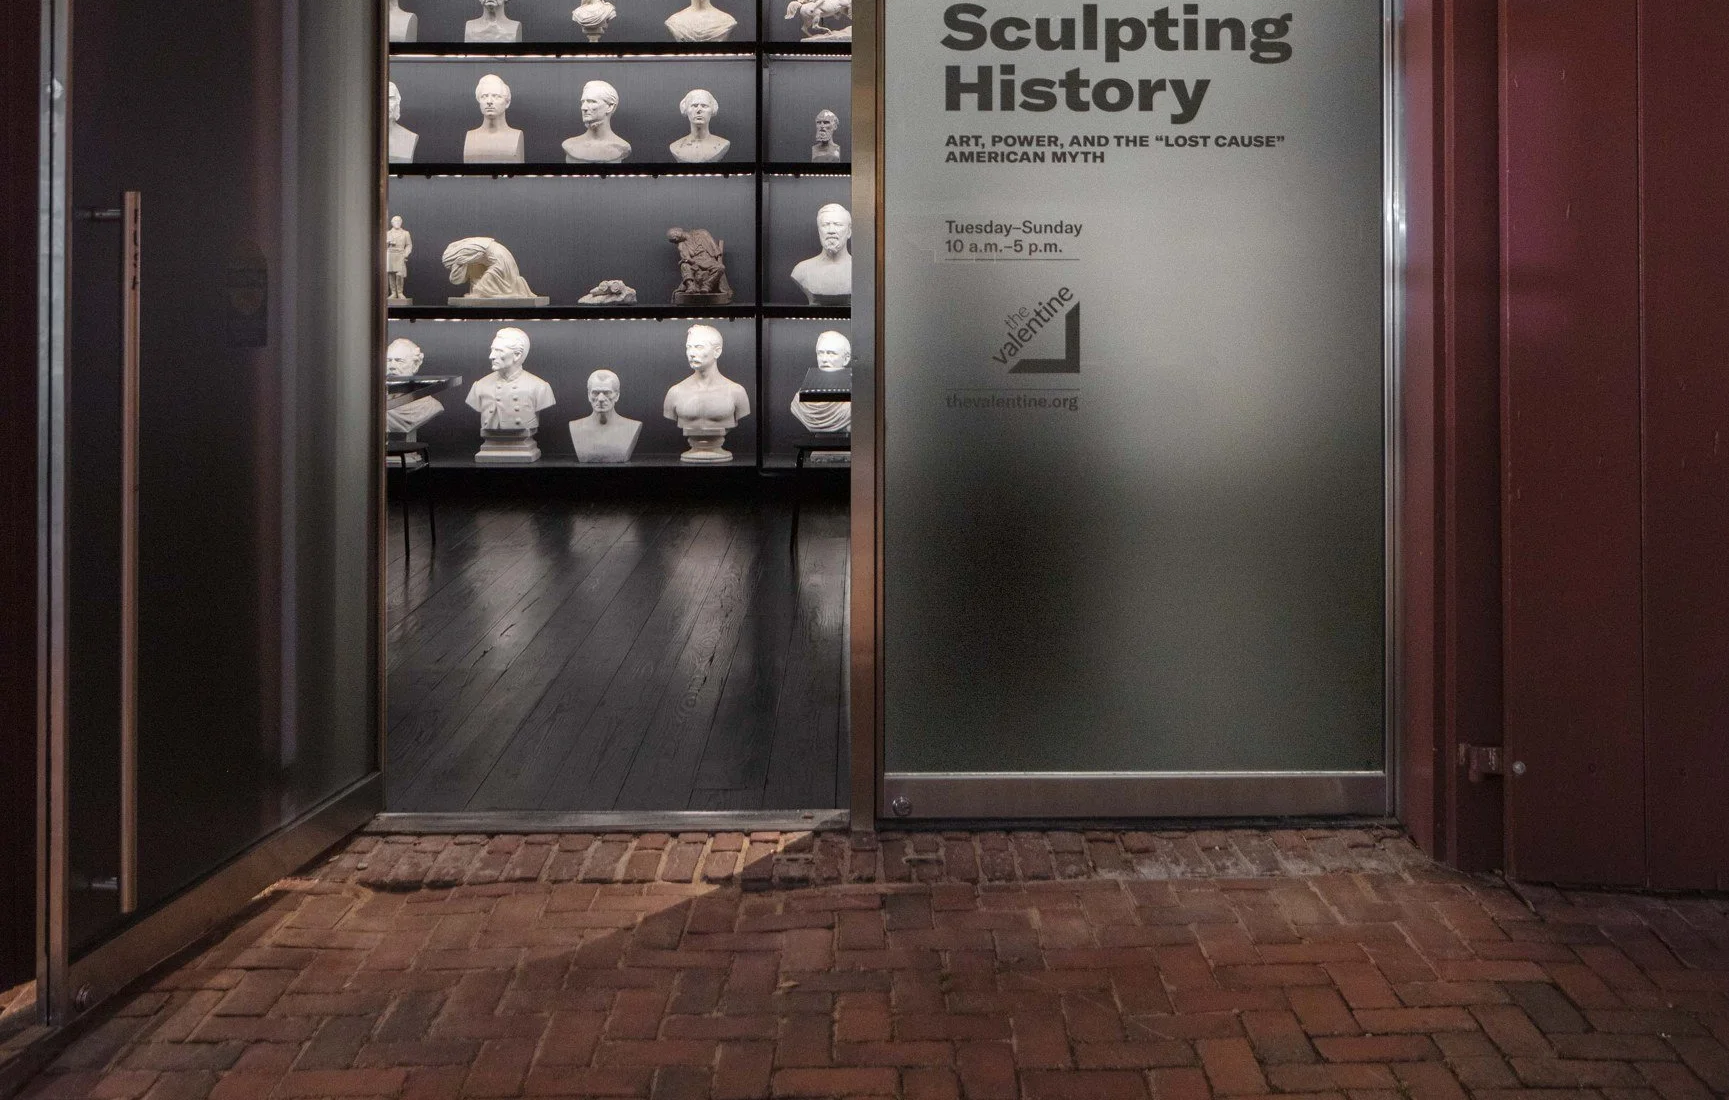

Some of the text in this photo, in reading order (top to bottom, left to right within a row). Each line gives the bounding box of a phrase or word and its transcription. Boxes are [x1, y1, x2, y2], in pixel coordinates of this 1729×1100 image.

[941, 2, 1294, 64] Sculpting
[945, 64, 1211, 125] History
[945, 134, 1286, 149] ART, POWER, AND THE “LOST CAUSE”
[945, 150, 1105, 164] AMERICAN MYTH
[945, 238, 964, 253] 10
[1028, 242, 1063, 256] p.m.
[992, 286, 1074, 366] valentine
[1005, 305, 1031, 331] the
[945, 394, 1078, 411] thevalentine.org
